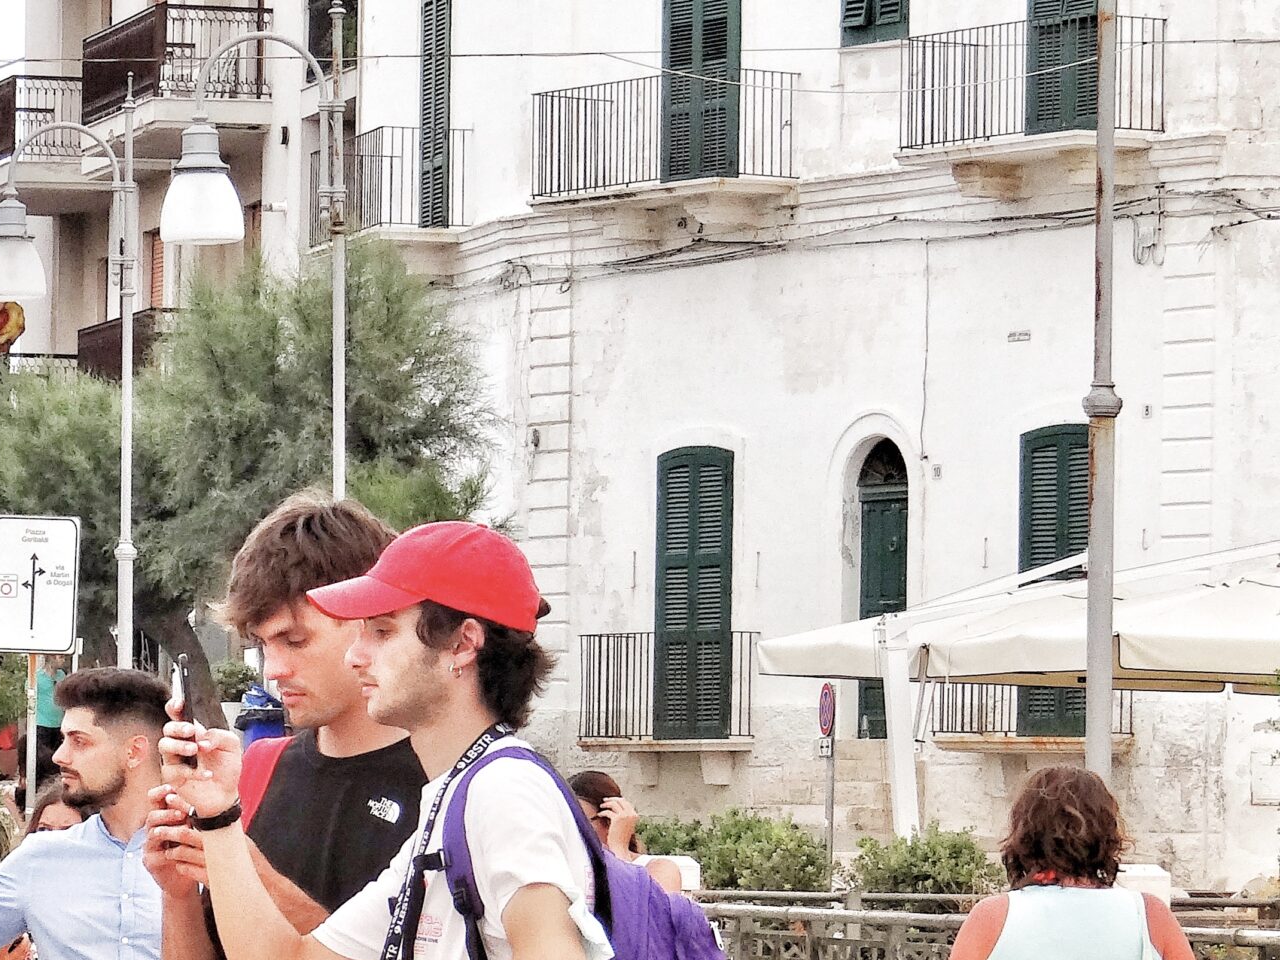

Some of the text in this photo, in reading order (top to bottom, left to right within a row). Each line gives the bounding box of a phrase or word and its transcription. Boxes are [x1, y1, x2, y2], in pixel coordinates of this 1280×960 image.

[933, 467, 941, 478] 10
[53, 579, 73, 587] Dogali
[367, 799, 389, 814] NORTH
